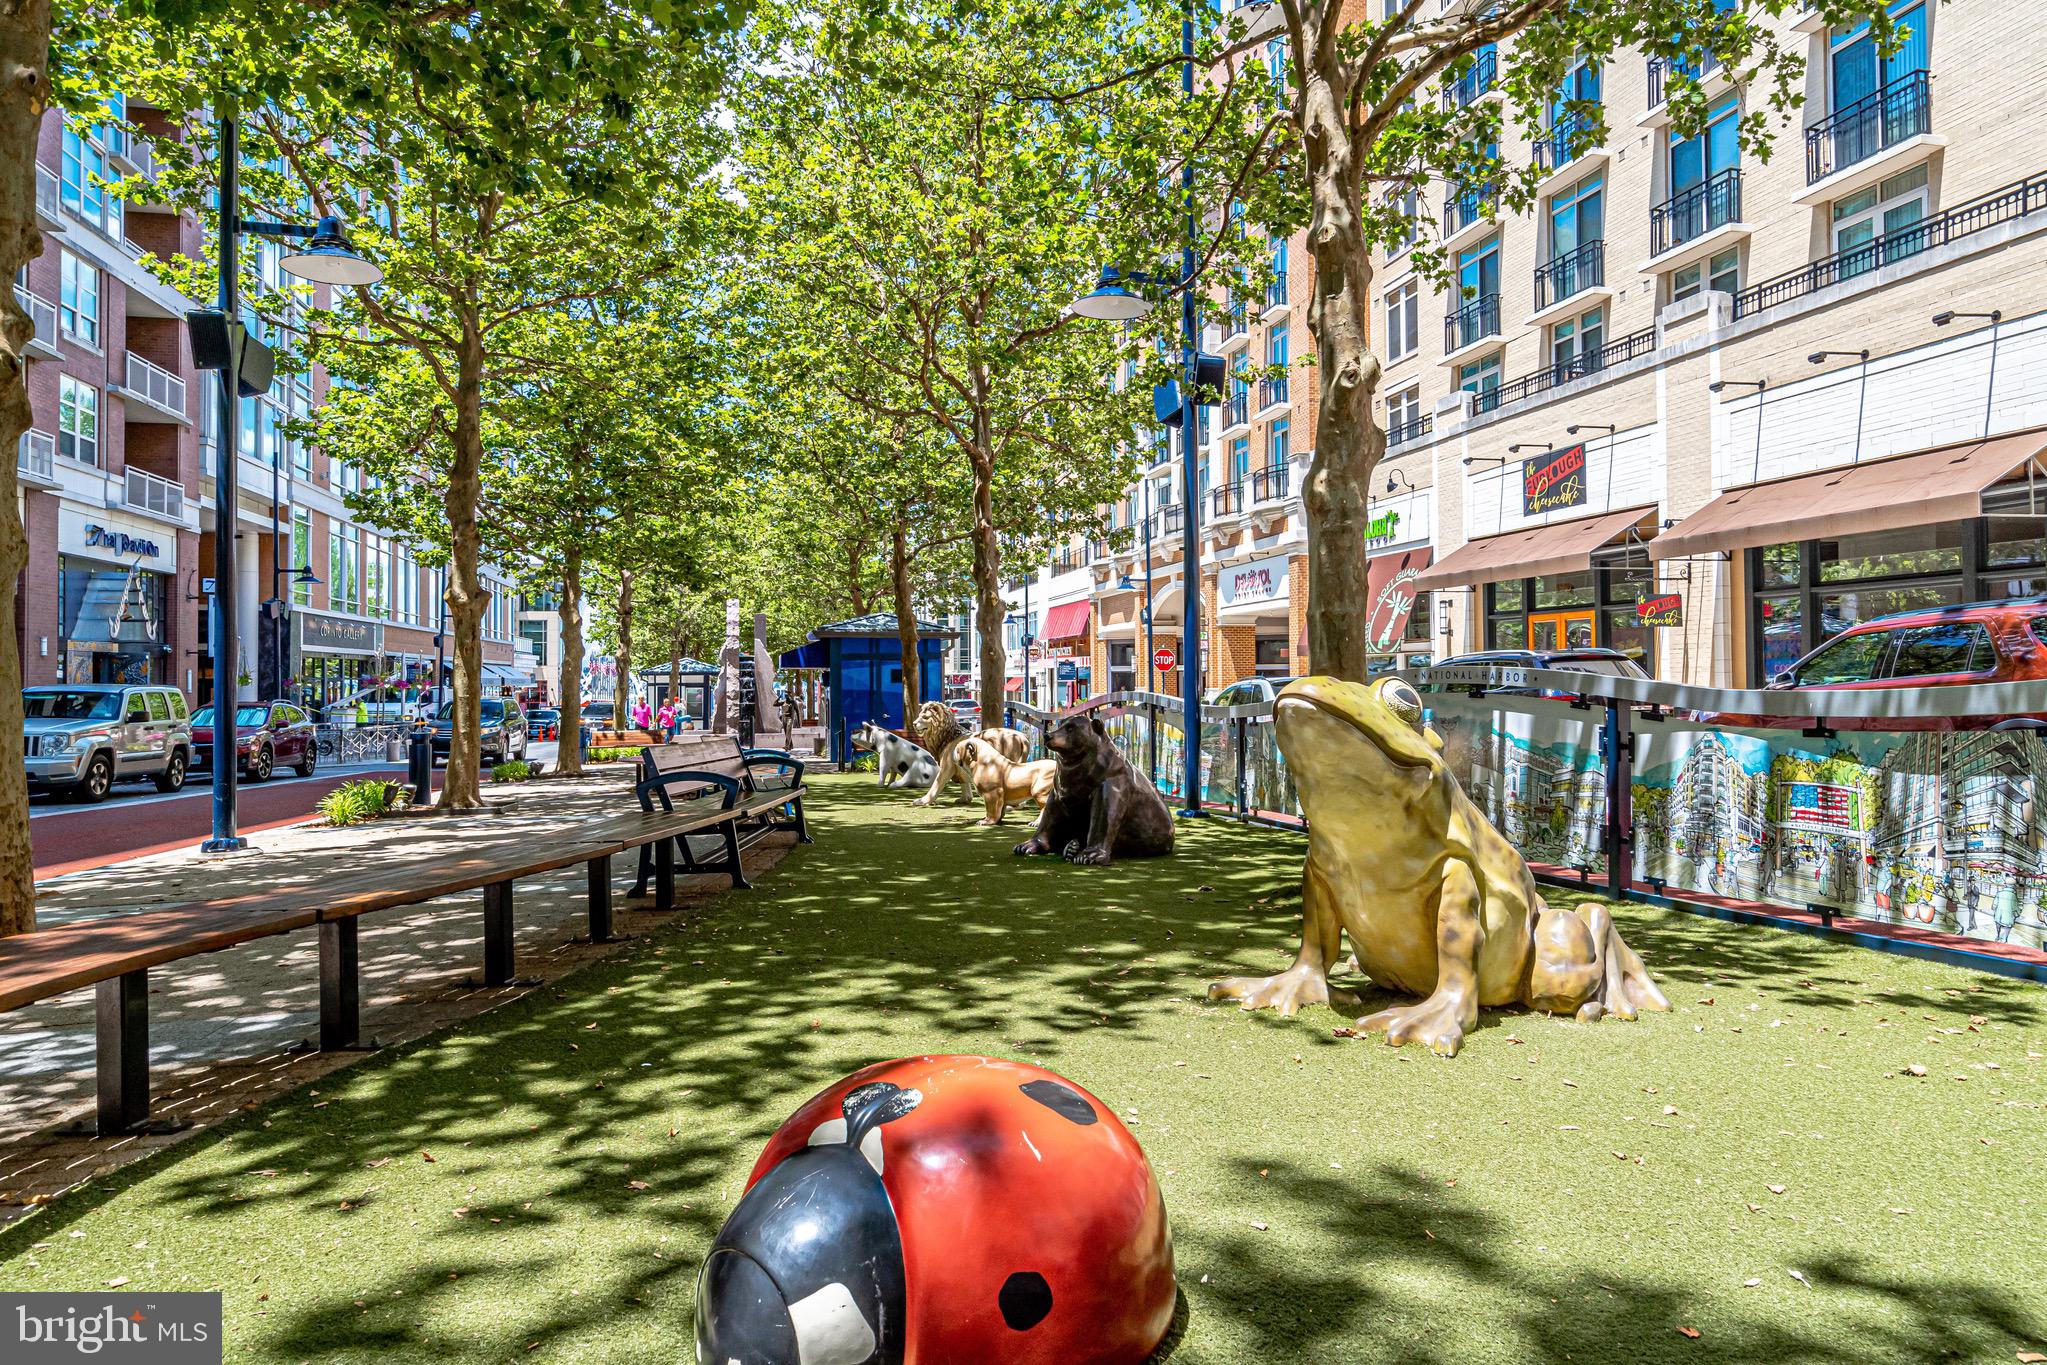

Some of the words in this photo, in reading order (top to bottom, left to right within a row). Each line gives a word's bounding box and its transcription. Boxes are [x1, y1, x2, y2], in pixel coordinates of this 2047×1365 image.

[1525, 448, 1584, 492] FURLOUGH
[1155, 656, 1173, 664] STOP
[1421, 670, 1472, 680] NATIONAL
[1481, 671, 1528, 683] HARBOR
